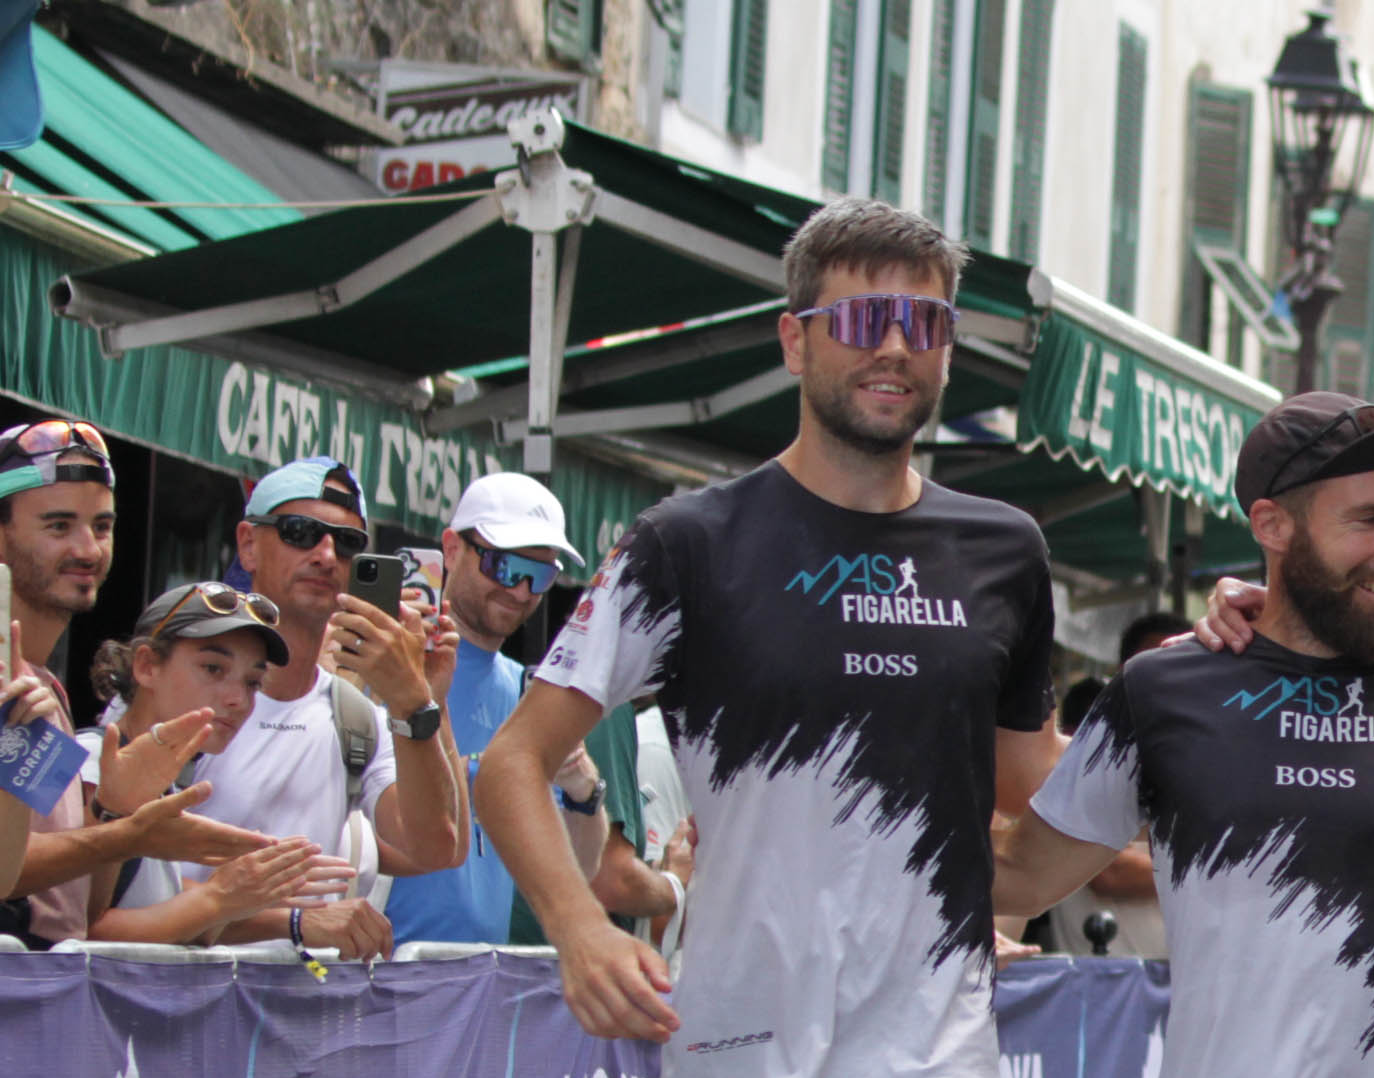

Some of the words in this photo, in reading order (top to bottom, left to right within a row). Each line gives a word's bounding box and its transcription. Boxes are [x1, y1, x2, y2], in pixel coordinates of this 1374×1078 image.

[1068, 341, 1121, 452] LE
[841, 594, 968, 627] FIGARELLA
[843, 652, 919, 677] BOSS
[1275, 764, 1357, 789] BOSS
